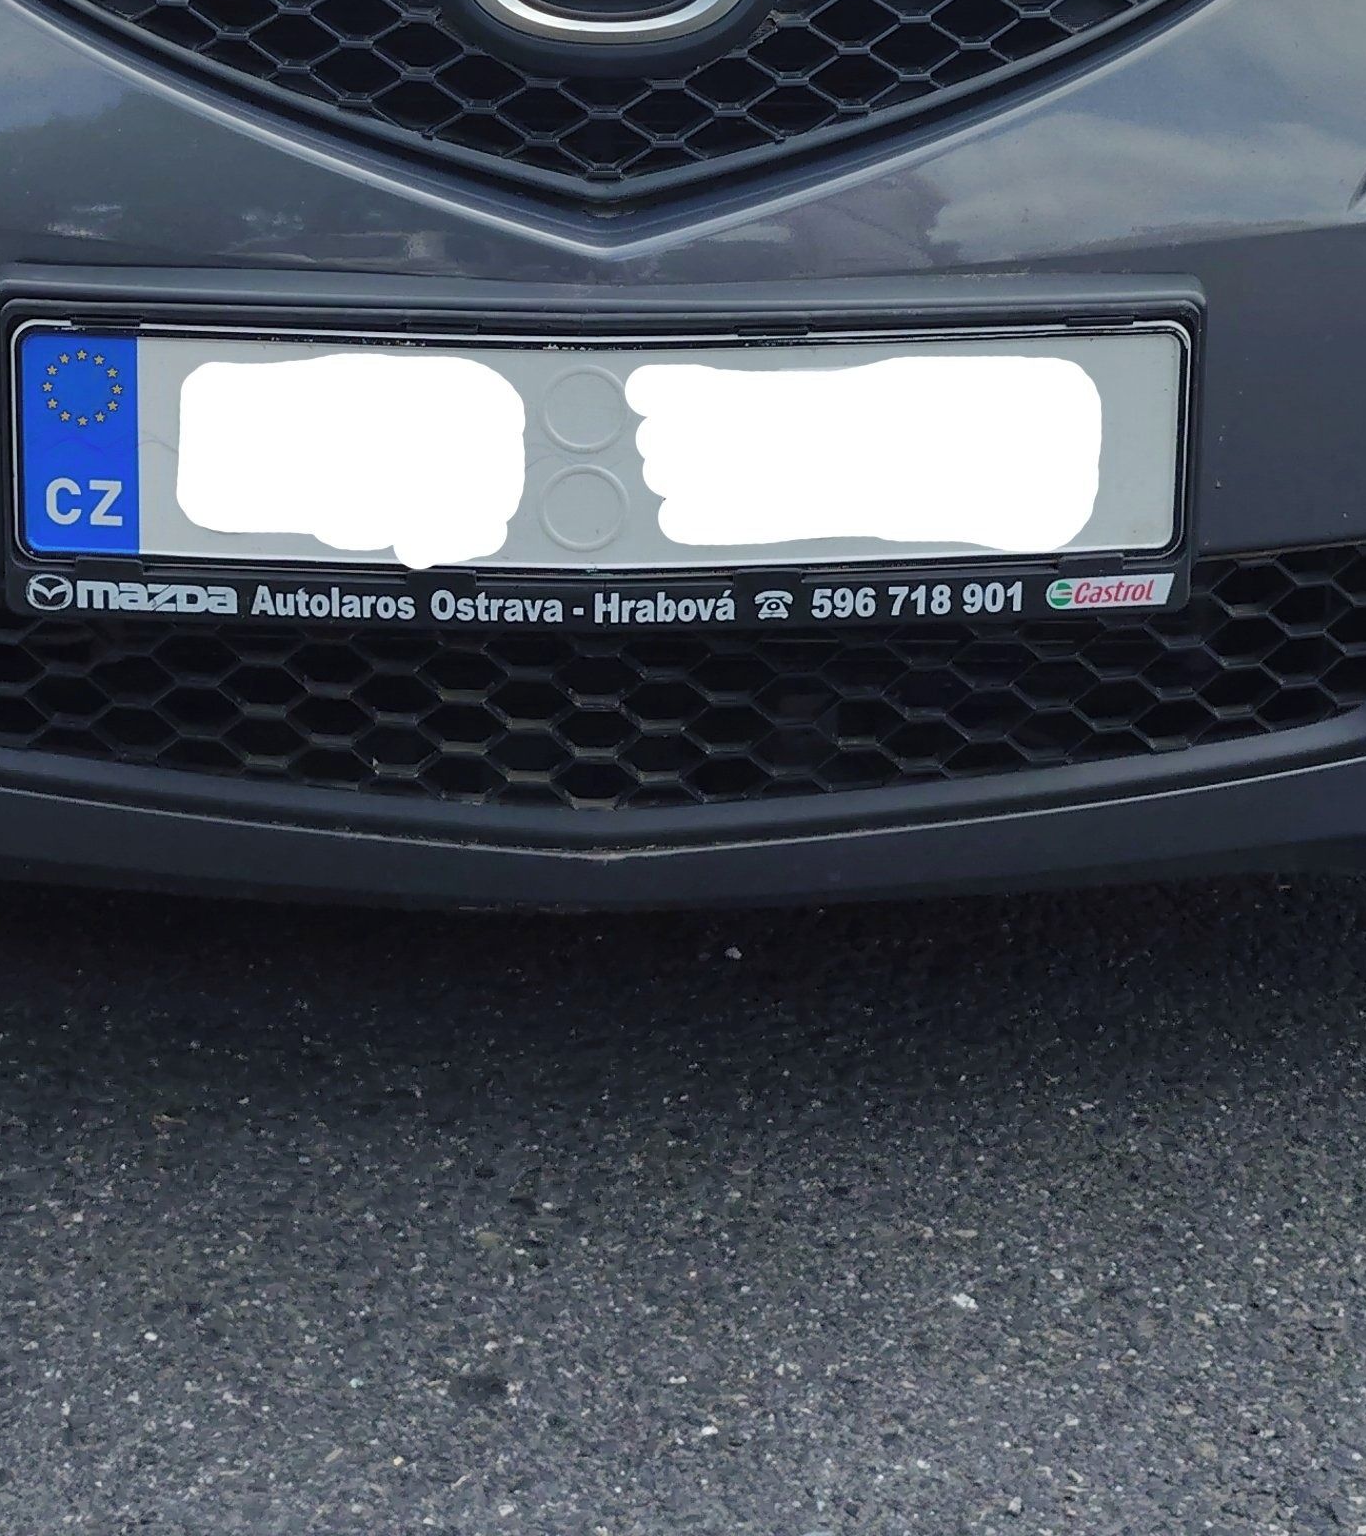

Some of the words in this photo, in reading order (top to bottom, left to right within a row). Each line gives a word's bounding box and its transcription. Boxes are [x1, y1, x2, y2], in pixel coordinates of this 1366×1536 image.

[45, 477, 123, 527] CZ
[251, 585, 416, 621] Autolaros
[430, 589, 563, 623] Ostrava
[593, 589, 735, 624] Hrabová
[810, 586, 877, 619] 596
[887, 584, 952, 617] 718
[961, 581, 1024, 614] 901
[1073, 579, 1155, 606] Castrol
